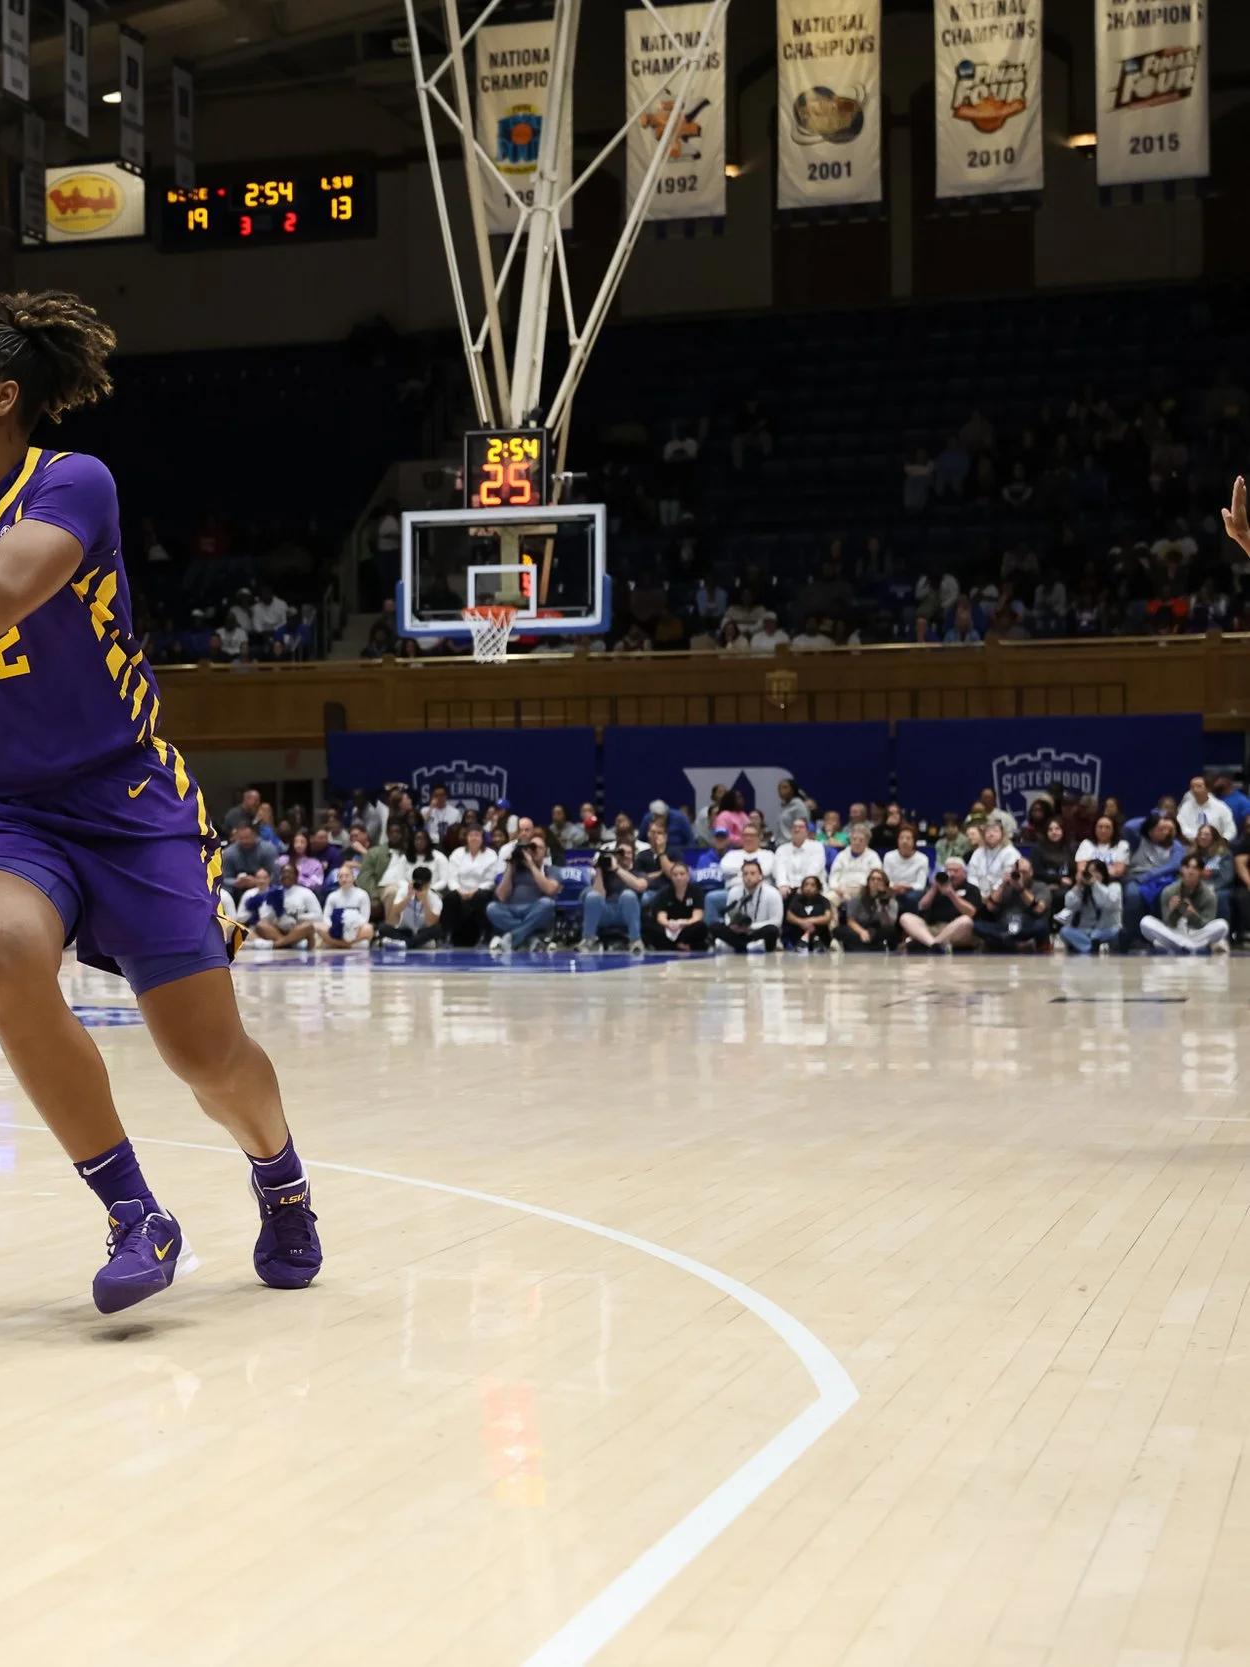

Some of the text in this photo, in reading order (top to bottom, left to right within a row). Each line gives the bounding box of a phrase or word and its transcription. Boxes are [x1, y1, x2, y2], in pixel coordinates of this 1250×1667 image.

[640, 31, 710, 52] NATIONA
[488, 48, 551, 69] NATIONA
[481, 71, 548, 93] CHAMPIO
[1129, 132, 1181, 155] 2015
[966, 147, 1015, 169] 2010
[807, 160, 853, 182] 2001
[321, 175, 354, 190] LSU
[656, 174, 698, 195] 1992
[244, 181, 294, 207] 2:54
[331, 195, 353, 220] 13
[188, 207, 208, 231] 19
[240, 215, 253, 236] 3
[284, 212, 298, 233] 2
[487, 437, 539, 463] 2:54
[481, 463, 531, 505] 25
[420, 780, 500, 804] SERHOOD
[1002, 769, 1093, 796] SISTERHOOD
[279, 1191, 306, 1205] LSU
